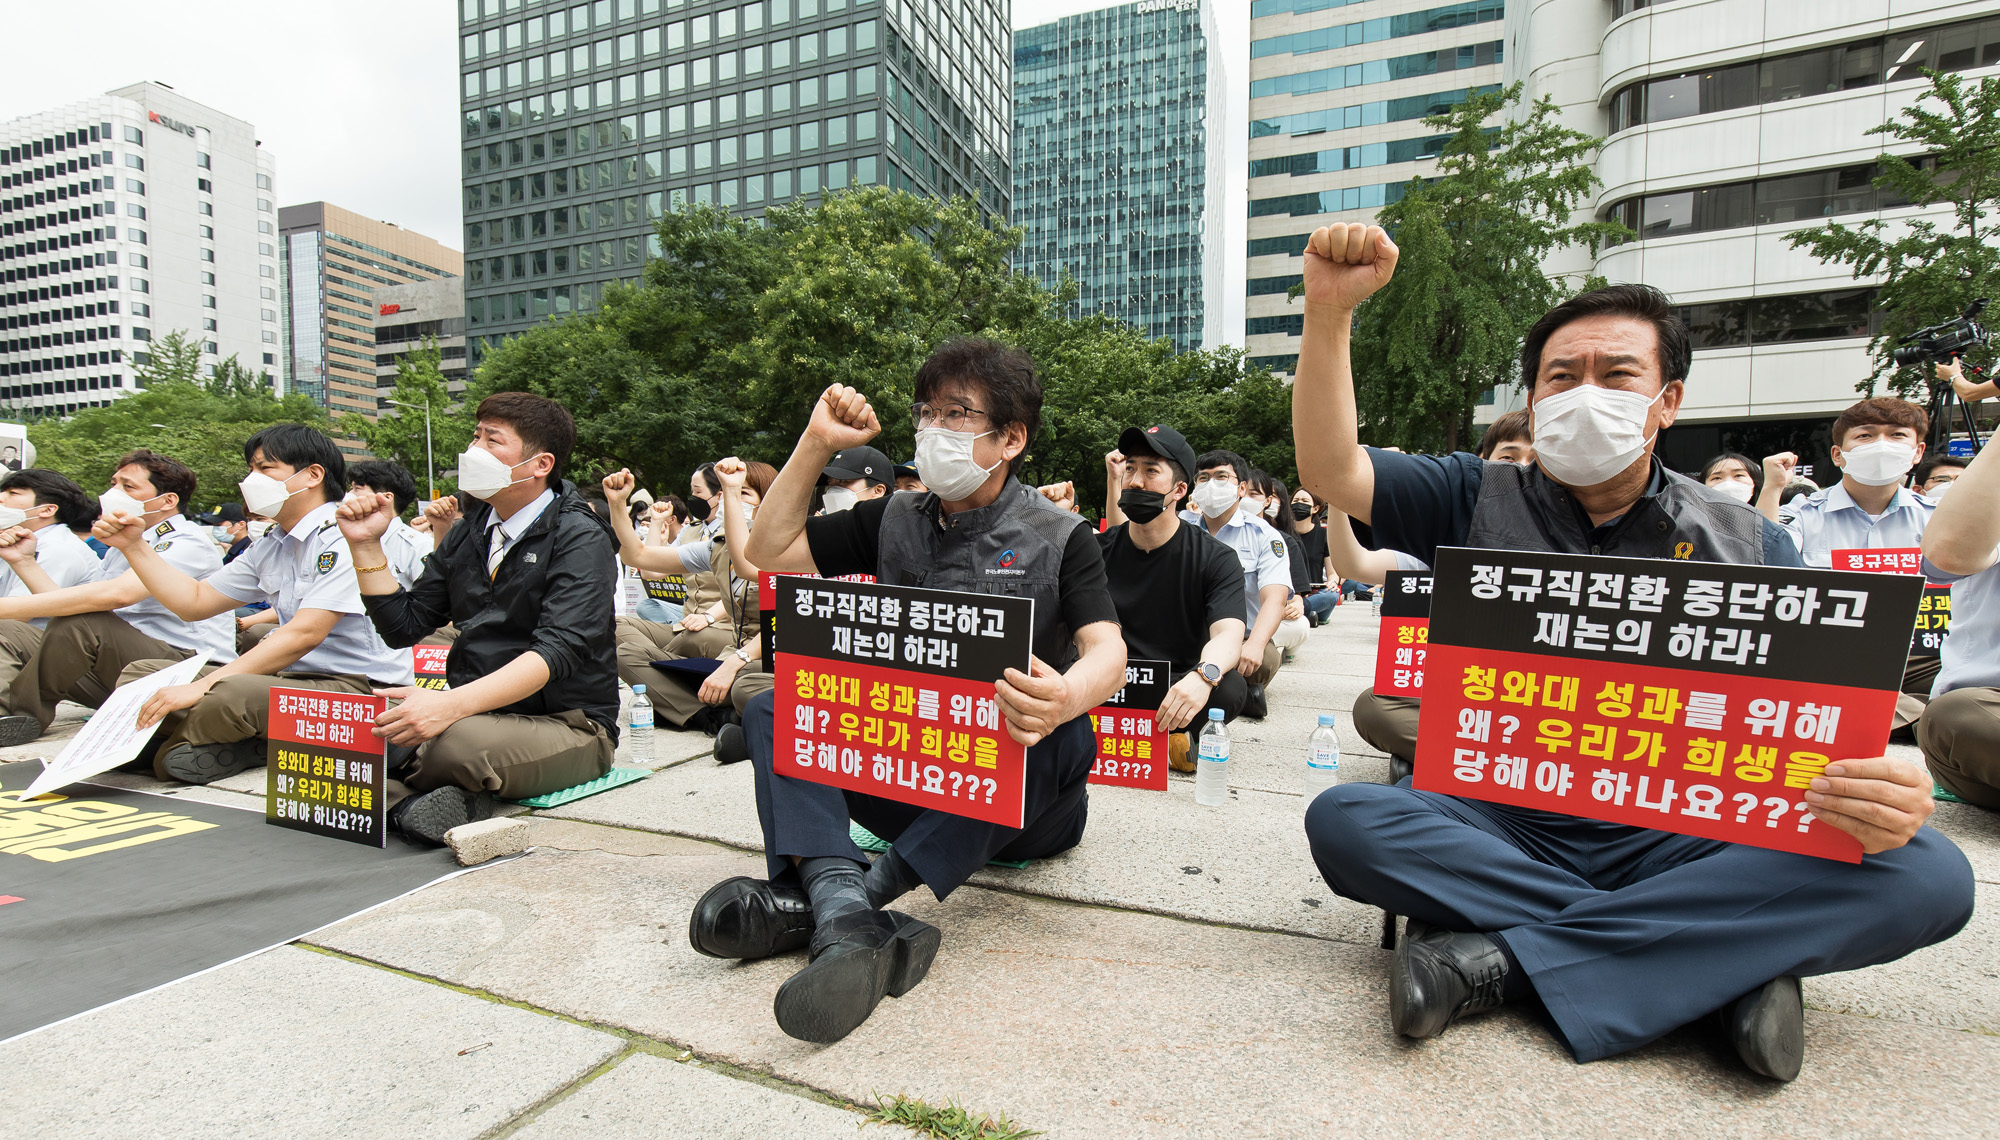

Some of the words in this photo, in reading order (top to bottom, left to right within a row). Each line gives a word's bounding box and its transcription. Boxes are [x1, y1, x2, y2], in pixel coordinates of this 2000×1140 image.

[1793, 465, 1813, 476] FE
[1848, 553, 1920, 569] 정규직전
[1400, 576, 1434, 594] 정규
[1469, 564, 1670, 613] 정규직전환
[1683, 579, 1869, 628] 중단하고
[795, 588, 902, 627] 정규직전환
[908, 600, 1005, 638] 중단하고
[1919, 595, 1951, 611] 성과
[1915, 614, 1949, 630] 리가
[415, 648, 450, 660] 정규직전
[831, 626, 895, 661] 재논의
[903, 634, 958, 668] 하라!
[1532, 611, 1653, 656] 재논의
[1668, 622, 1772, 666] 하라!
[1395, 647, 1427, 666] 왜?
[1125, 666, 1154, 685] 하고
[278, 694, 329, 718] 정규직전환
[331, 700, 375, 723] 중단하고
[795, 669, 861, 707] 청와대
[869, 681, 940, 721] 성과를
[949, 694, 999, 731] 위해
[1461, 664, 1581, 712] 청와대
[1595, 680, 1728, 731] 성과를
[1744, 698, 1842, 745] 위해
[295, 719, 326, 741] 재논의
[329, 723, 354, 744] 하라!
[794, 704, 831, 734] 왜?
[838, 712, 911, 752] 우리가
[920, 726, 999, 770] 희생을
[1120, 717, 1152, 737] 위해
[1102, 737, 1152, 760] 희생을
[1455, 707, 1521, 744] 왜?
[1534, 718, 1667, 768] 우리가
[1682, 736, 1831, 790] 희생을
[277, 749, 309, 774] 청와대
[312, 755, 346, 780] 성과를
[349, 761, 373, 784] 위해
[794, 737, 863, 778] 당해야
[872, 752, 998, 805] 하나요???
[1089, 758, 1152, 779] 나요???
[276, 773, 295, 794] 왜?
[298, 777, 333, 802] 우리가
[336, 783, 373, 811] 희생을
[1452, 747, 1575, 797] 당해야
[1591, 768, 1818, 834] 하나요???
[276, 797, 310, 823] 당해야
[313, 804, 373, 834] 하나요???
